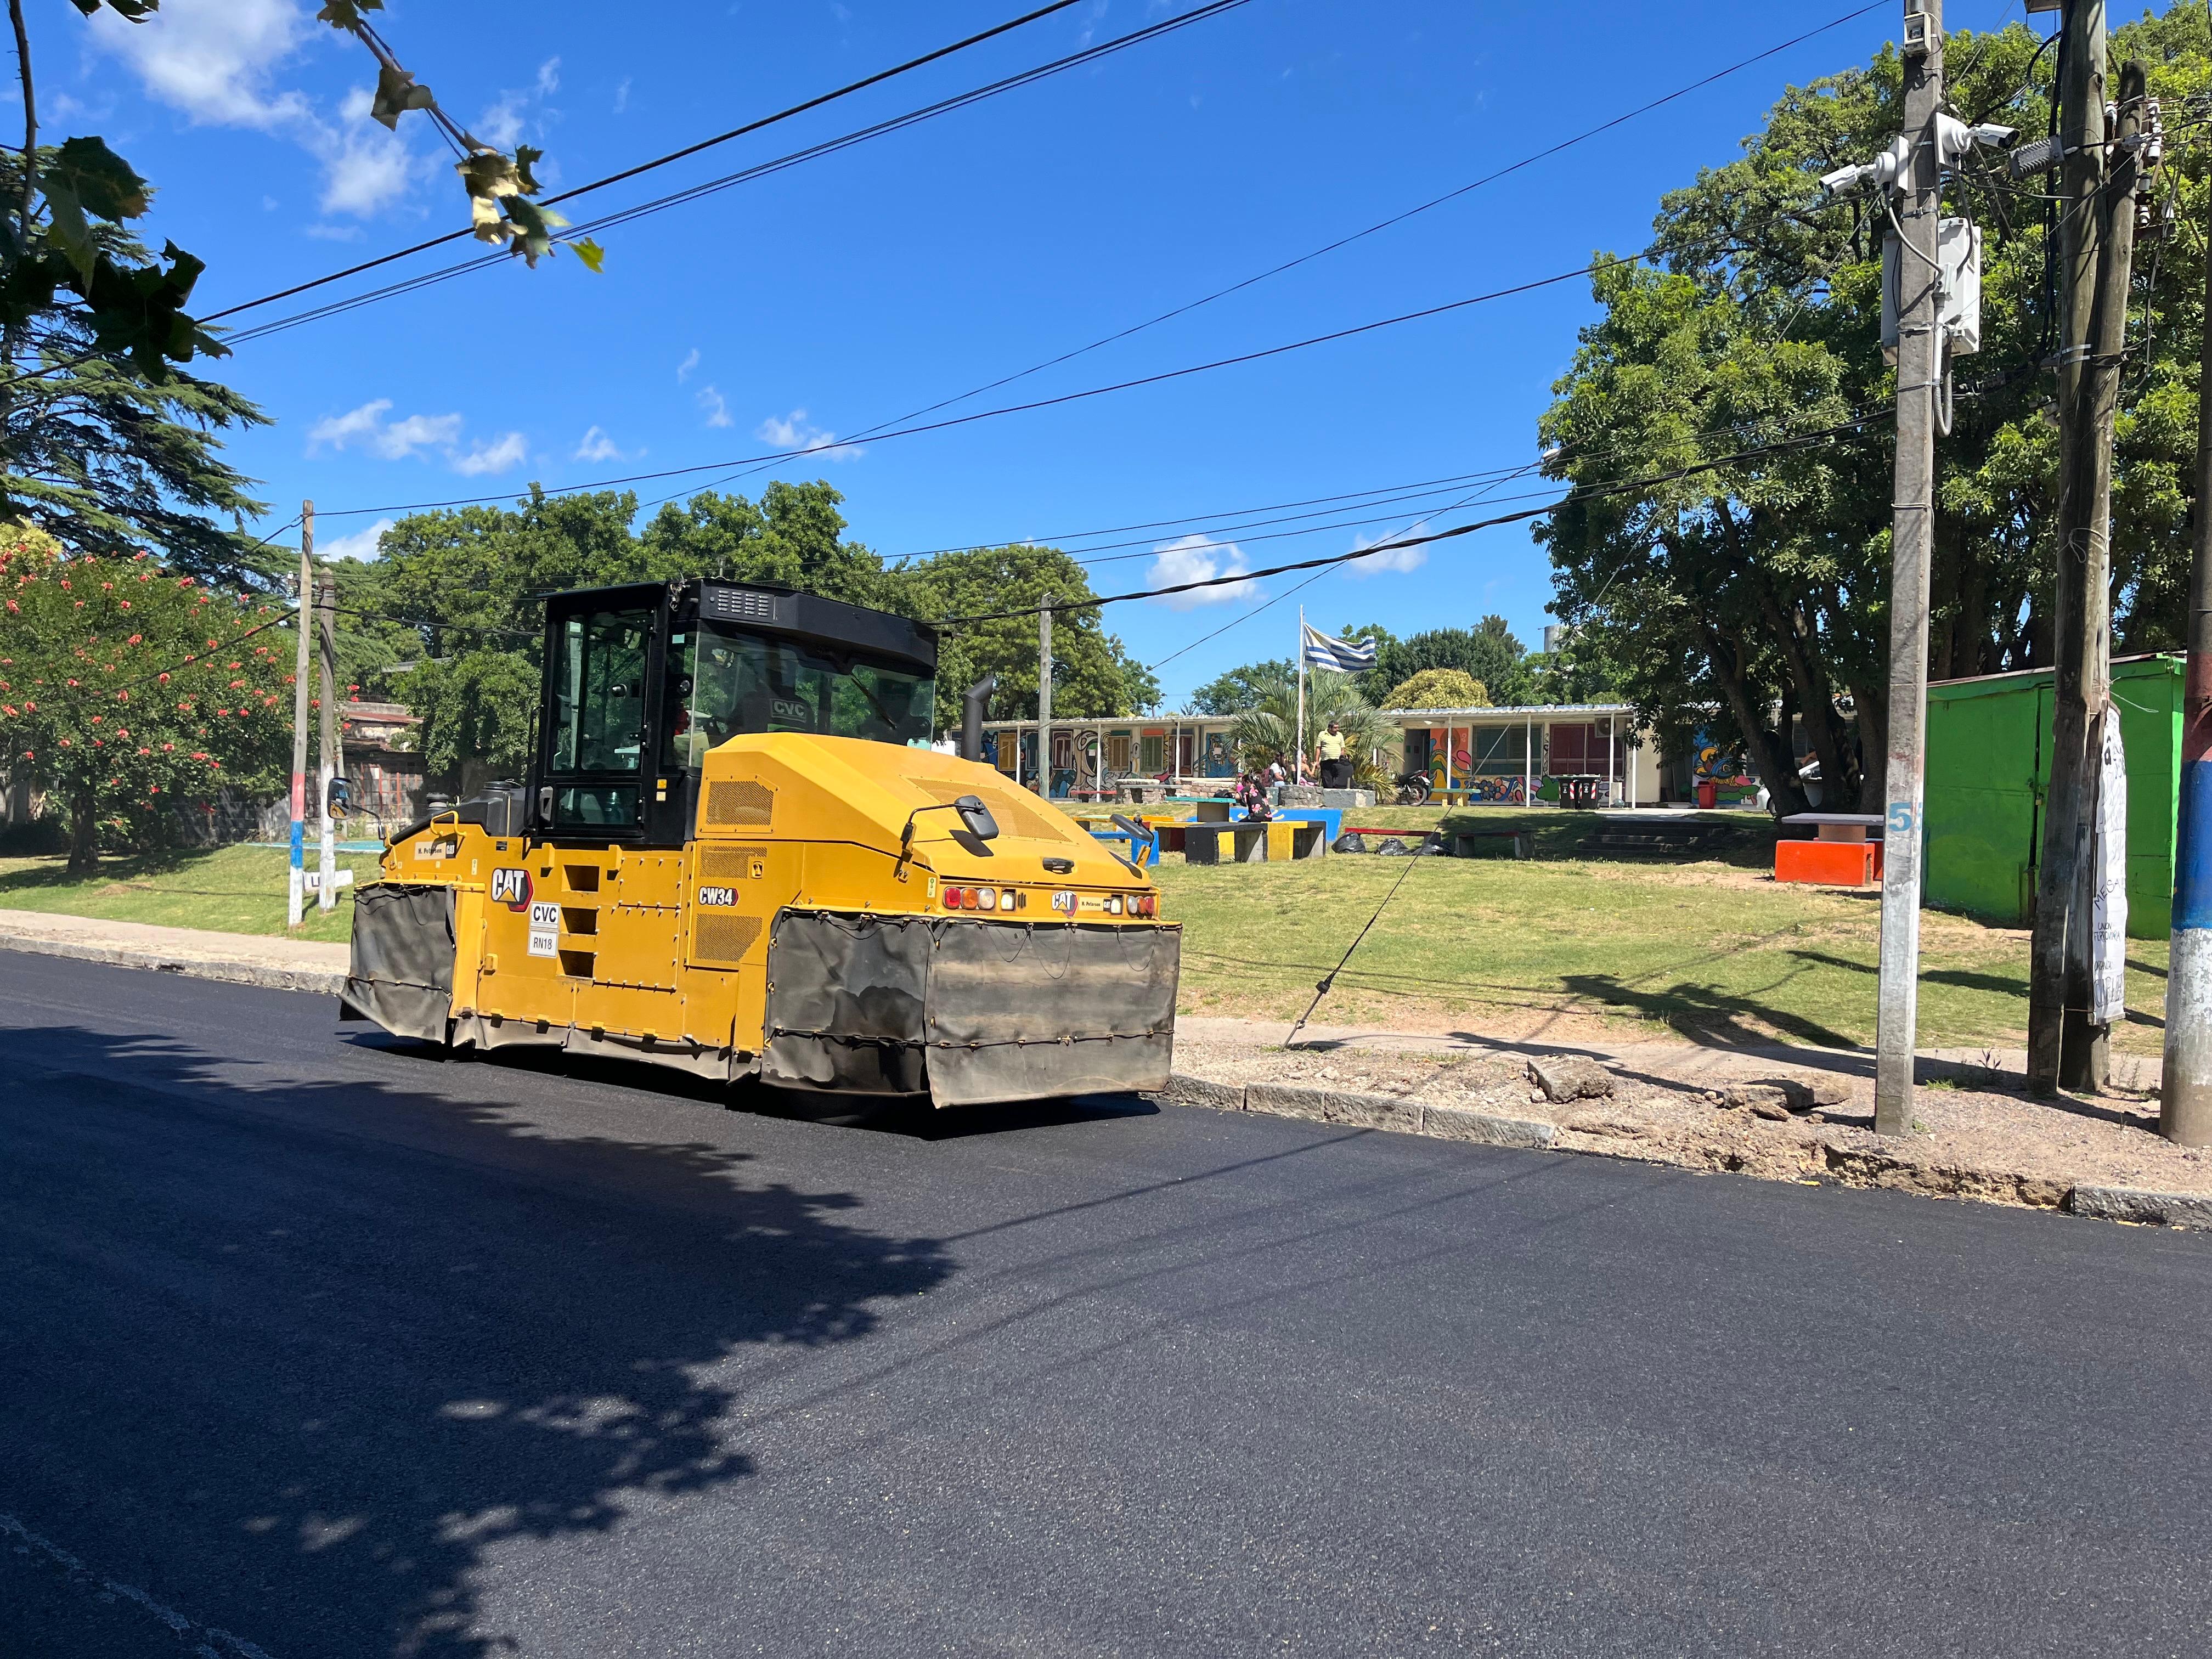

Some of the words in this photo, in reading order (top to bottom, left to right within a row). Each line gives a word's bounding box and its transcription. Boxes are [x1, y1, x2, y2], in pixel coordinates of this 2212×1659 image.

[774, 701, 804, 716] CVC
[1888, 803, 1911, 832] 5
[492, 868, 524, 902] CAT
[699, 887, 732, 905] CW34
[1052, 891, 1073, 910] CAT
[533, 906, 556, 923] CVC
[533, 937, 552, 950] RN18
